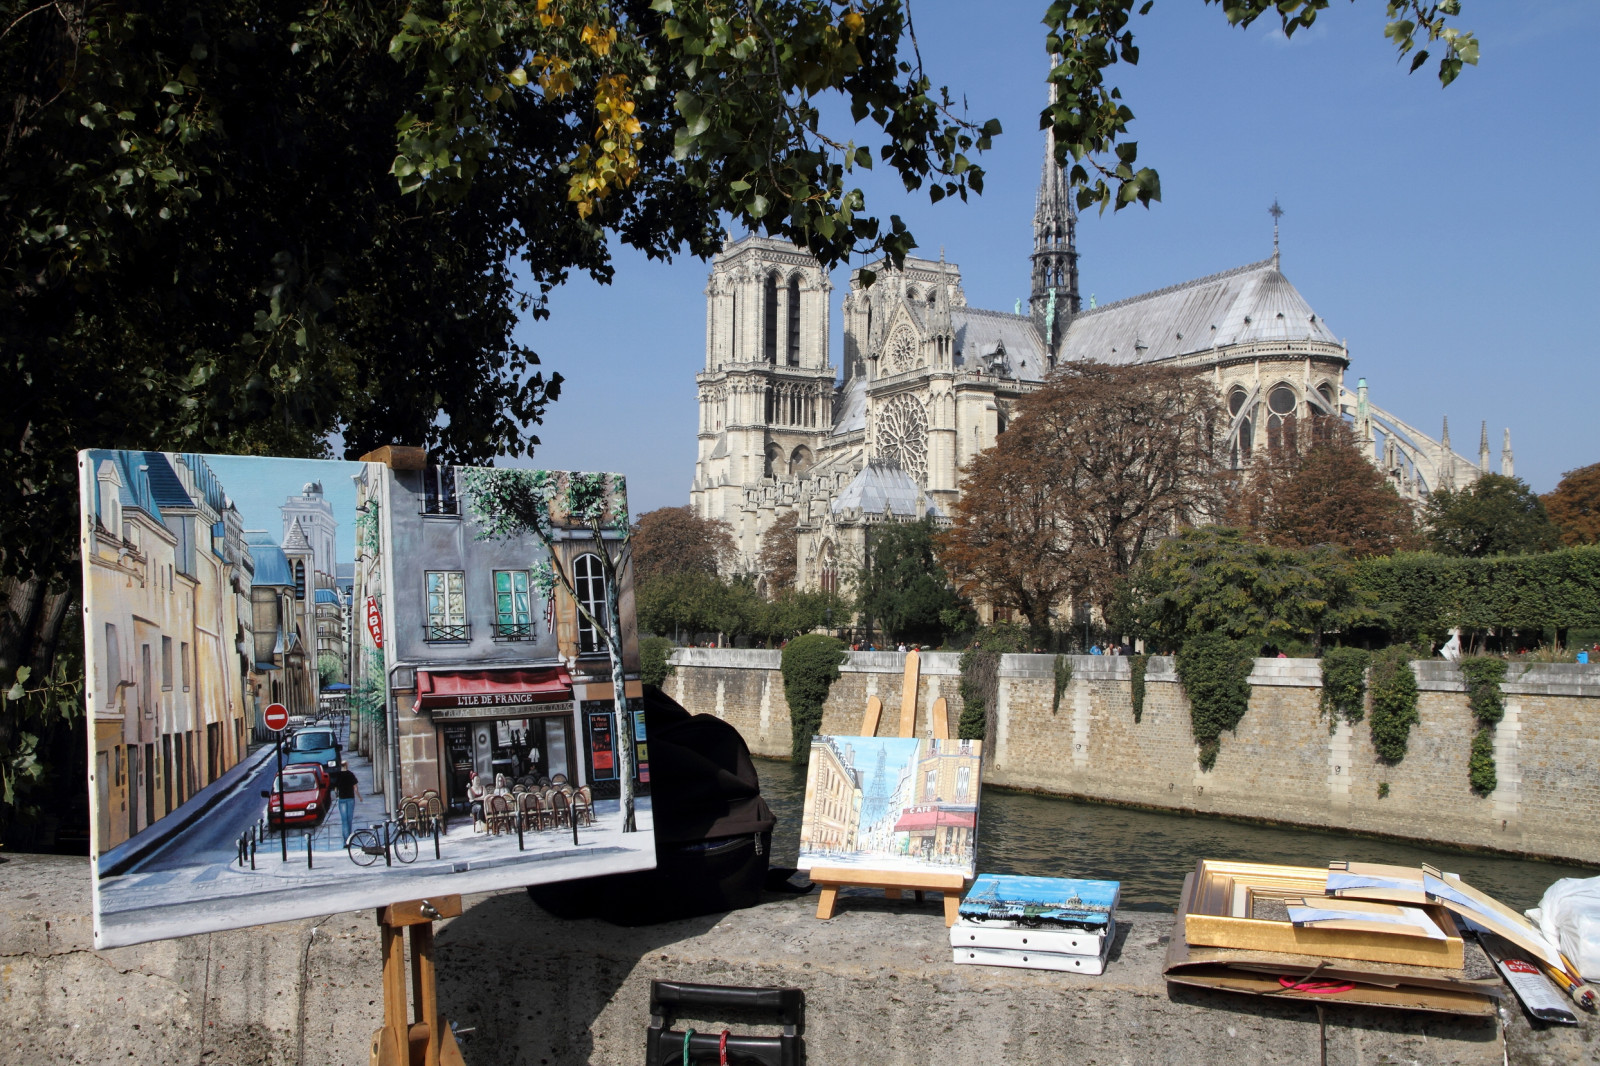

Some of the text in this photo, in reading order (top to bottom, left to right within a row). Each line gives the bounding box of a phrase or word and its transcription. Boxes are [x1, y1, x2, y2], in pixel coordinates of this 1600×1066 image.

[368, 597, 381, 643] TABAC
[457, 694, 533, 706] L'ILE DE FRANCE
